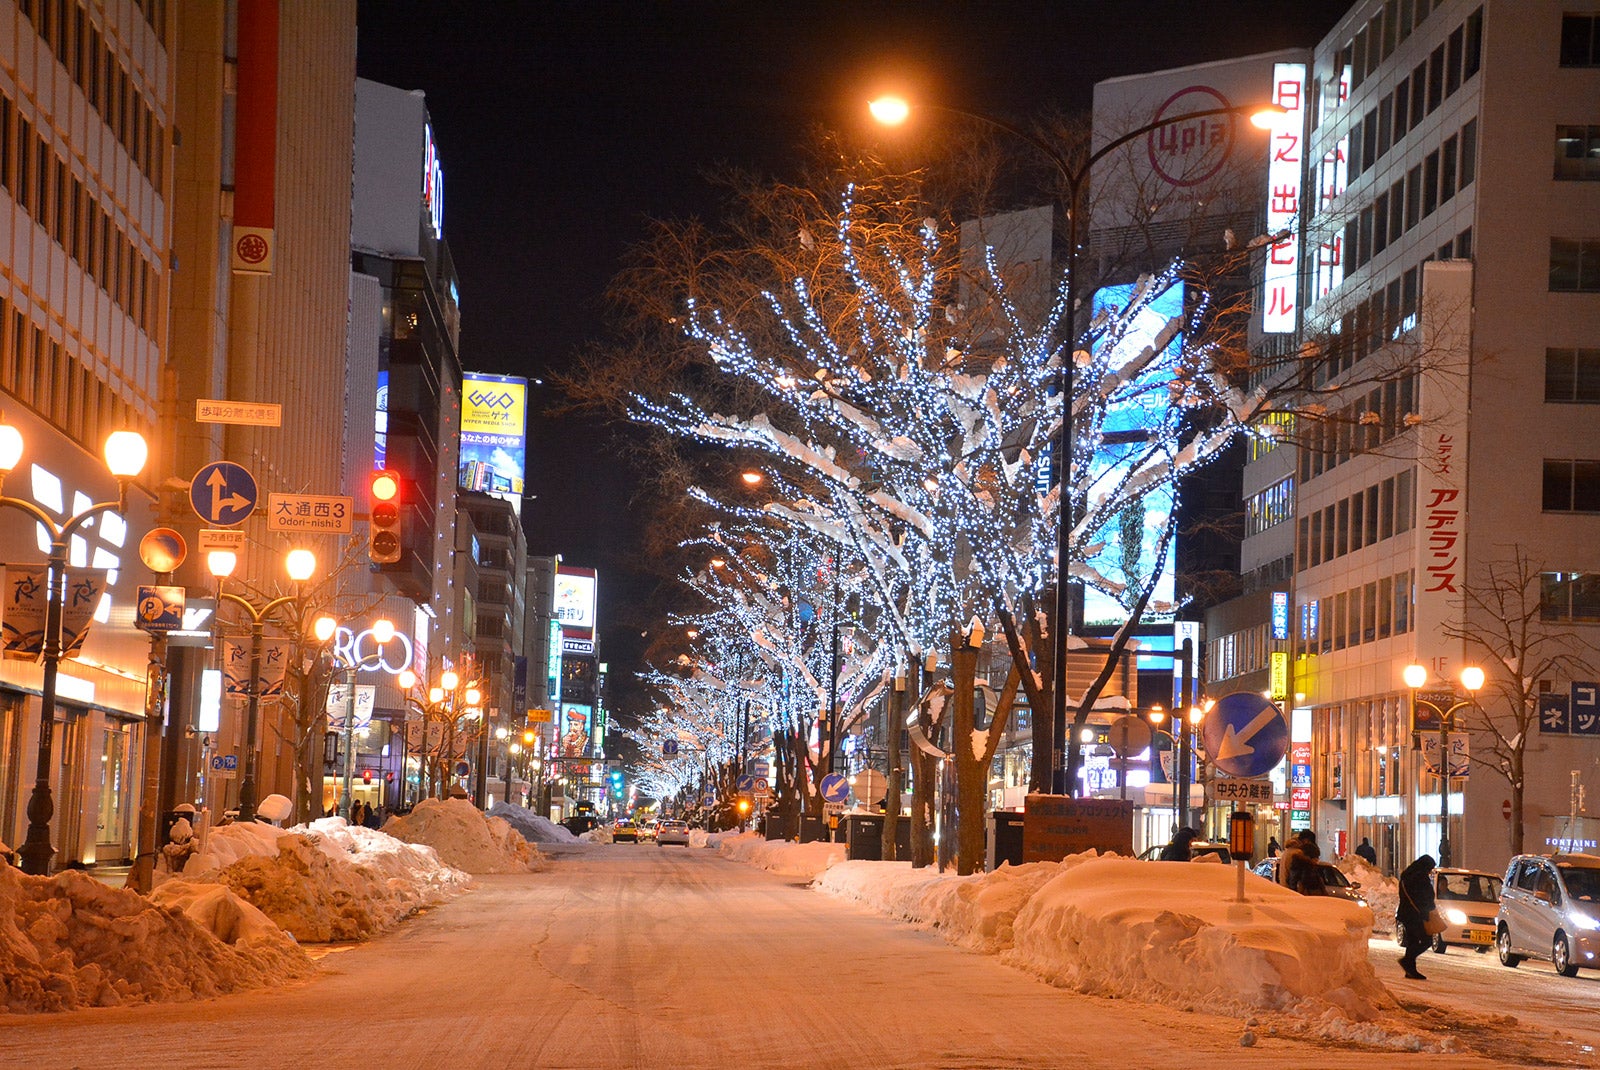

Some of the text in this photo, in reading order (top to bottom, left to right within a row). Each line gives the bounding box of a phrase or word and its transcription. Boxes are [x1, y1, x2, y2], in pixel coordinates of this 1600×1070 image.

[468, 389, 514, 409] GEO
[201, 406, 275, 420] 歩車分離式信号
[276, 500, 345, 518] 大通西3
[1425, 488, 1459, 594] アデランス
[1431, 656, 1448, 671] 1F
[1217, 782, 1271, 799] 中央分離帯
[1545, 837, 1598, 848] FONTAINE
